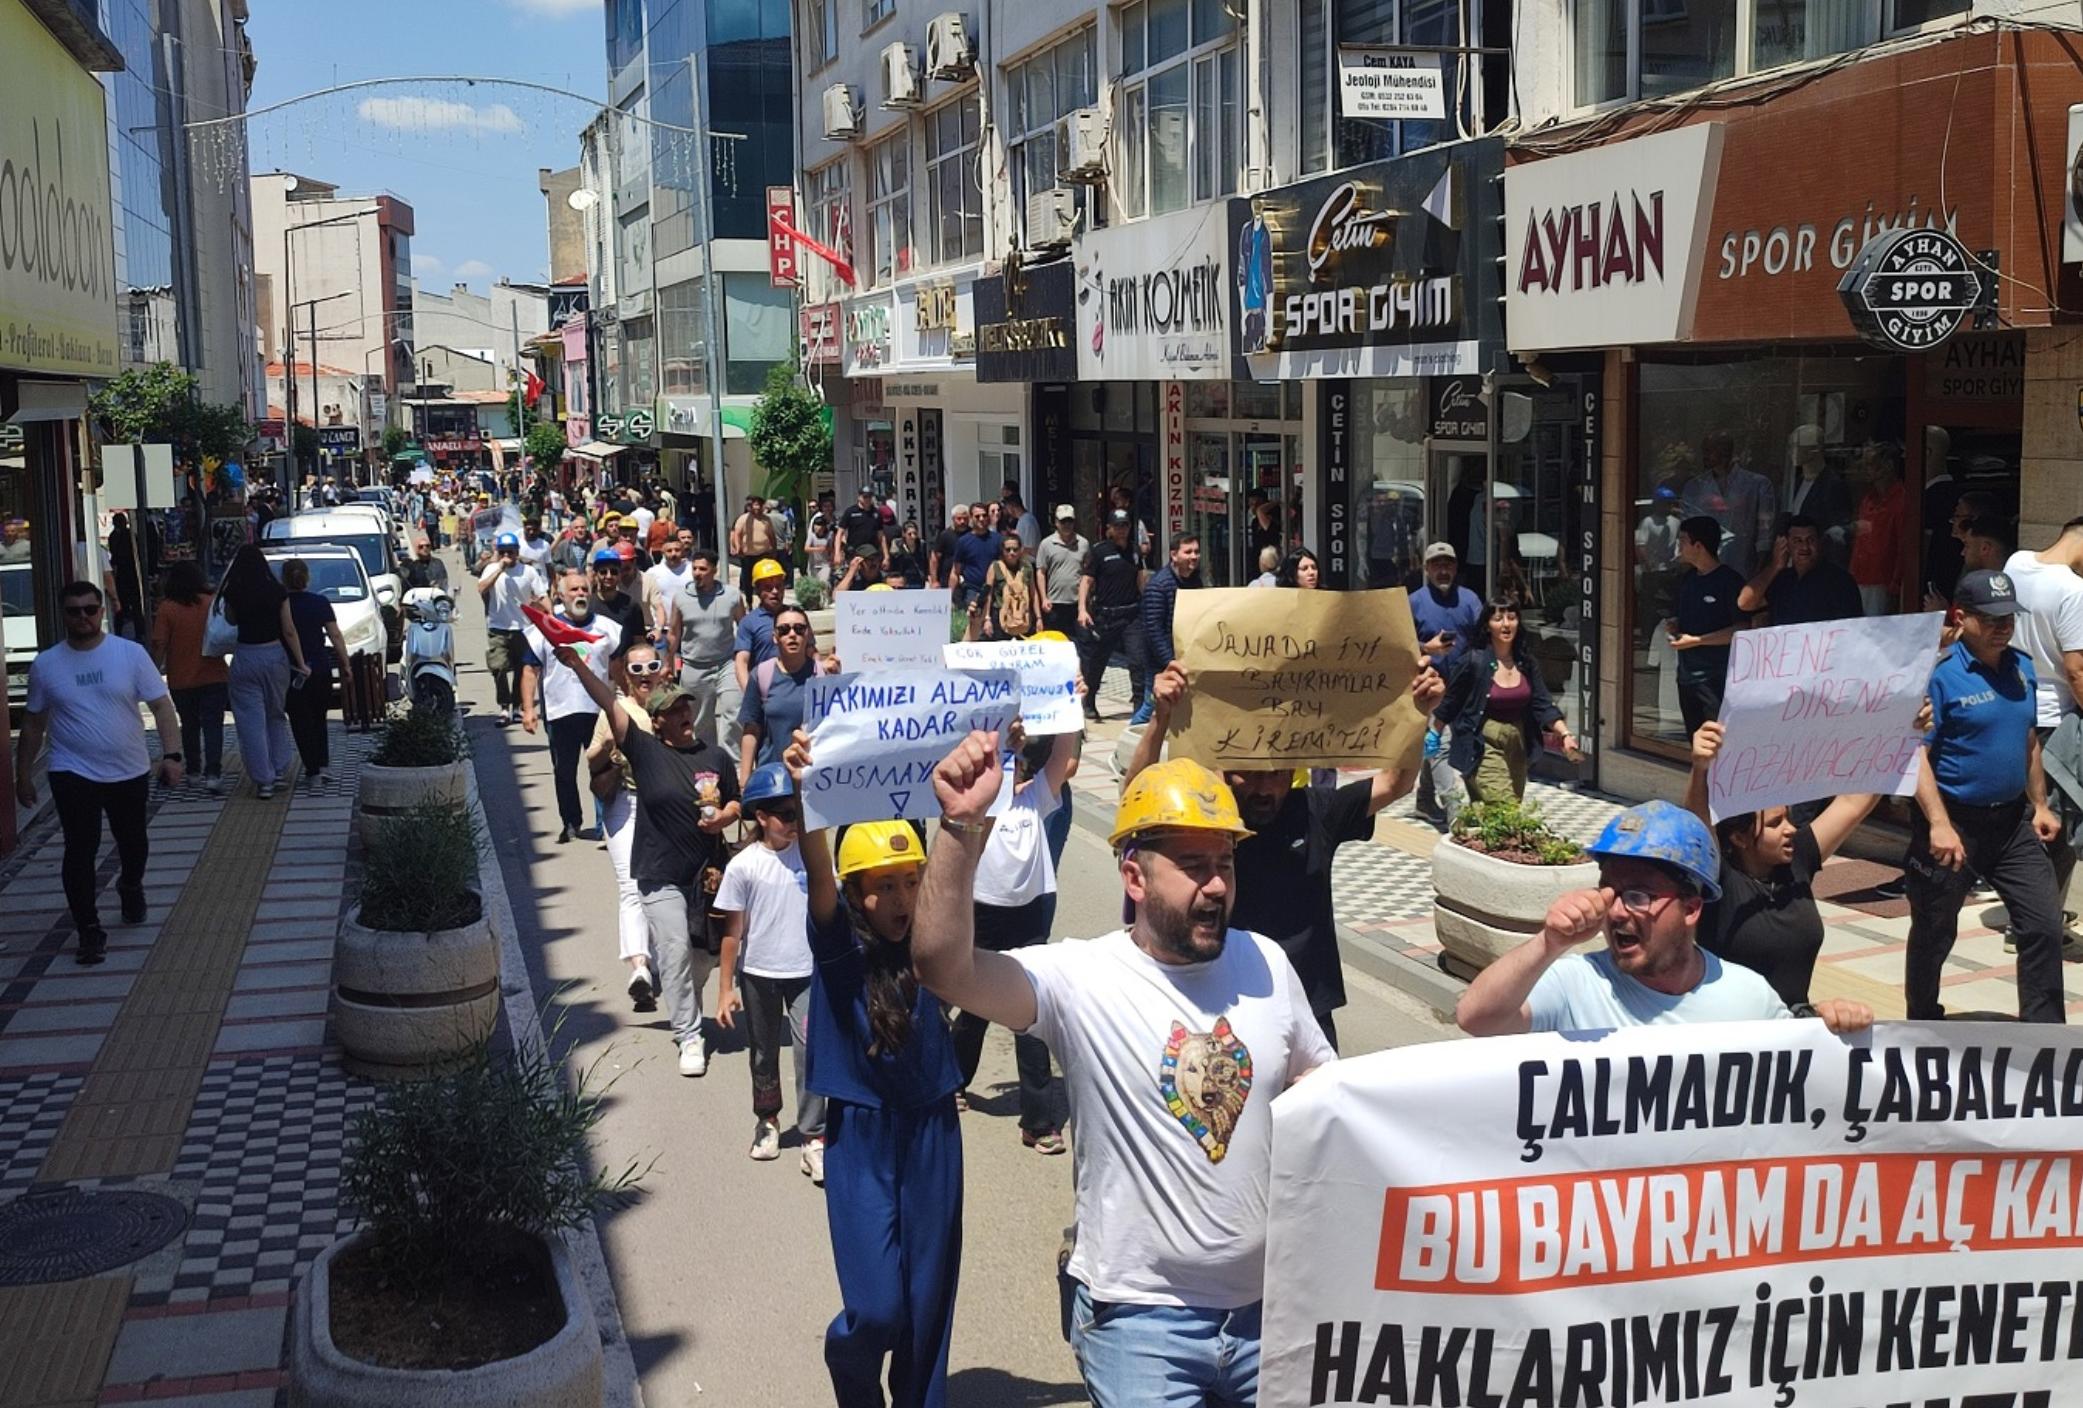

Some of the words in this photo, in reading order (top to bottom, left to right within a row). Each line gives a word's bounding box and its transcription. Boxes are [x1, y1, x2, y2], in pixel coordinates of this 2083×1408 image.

[1345, 74, 1381, 90] Jeoloji
[1383, 74, 1436, 89] Mühendisi
[1363, 54, 1387, 68] Cem
[1389, 55, 1416, 68] KAYA
[774, 210, 792, 275] CHP
[1516, 187, 1664, 295] AYHAN
[1718, 222, 1817, 281] SPOR
[1891, 238, 1958, 271] AYHAN
[1109, 275, 1137, 336] AKIN
[1143, 253, 1223, 335] KOZMETİK
[1286, 286, 1357, 337] SPOR
[1889, 281, 1952, 301] SPOR
[1887, 315, 1952, 344] GİYİM
[1169, 384, 1182, 445] AKIN
[1943, 378, 1987, 396] SPOR
[1330, 393, 1345, 482] ÇETİN
[1434, 421, 1458, 436] SPOR
[1583, 392, 1595, 504] ÇETİN
[903, 420, 917, 521] AKTARİ
[1331, 503, 1345, 572] SPOR
[1582, 530, 1594, 618] SPOR
[999, 644, 1046, 658] GÜZEL
[811, 684, 916, 719] HAKIMIZI
[930, 680, 1012, 704] ALANA
[1239, 667, 1390, 693] BAYRAMLAR
[1260, 696, 1323, 719] BAY
[878, 710, 957, 742] KADAR
[1516, 1049, 1827, 1163] ÇALMADIK,
[1400, 1190, 1500, 1283] BU
[1516, 1166, 1788, 1282] BAYRAM
[1799, 1162, 1882, 1251] DA
[1897, 1159, 1983, 1253] AÇ
[1990, 1158, 2083, 1240] KA
[1310, 1304, 1740, 1408] HAKLARIMIZ
[1748, 1275, 1865, 1408] İÇİN
